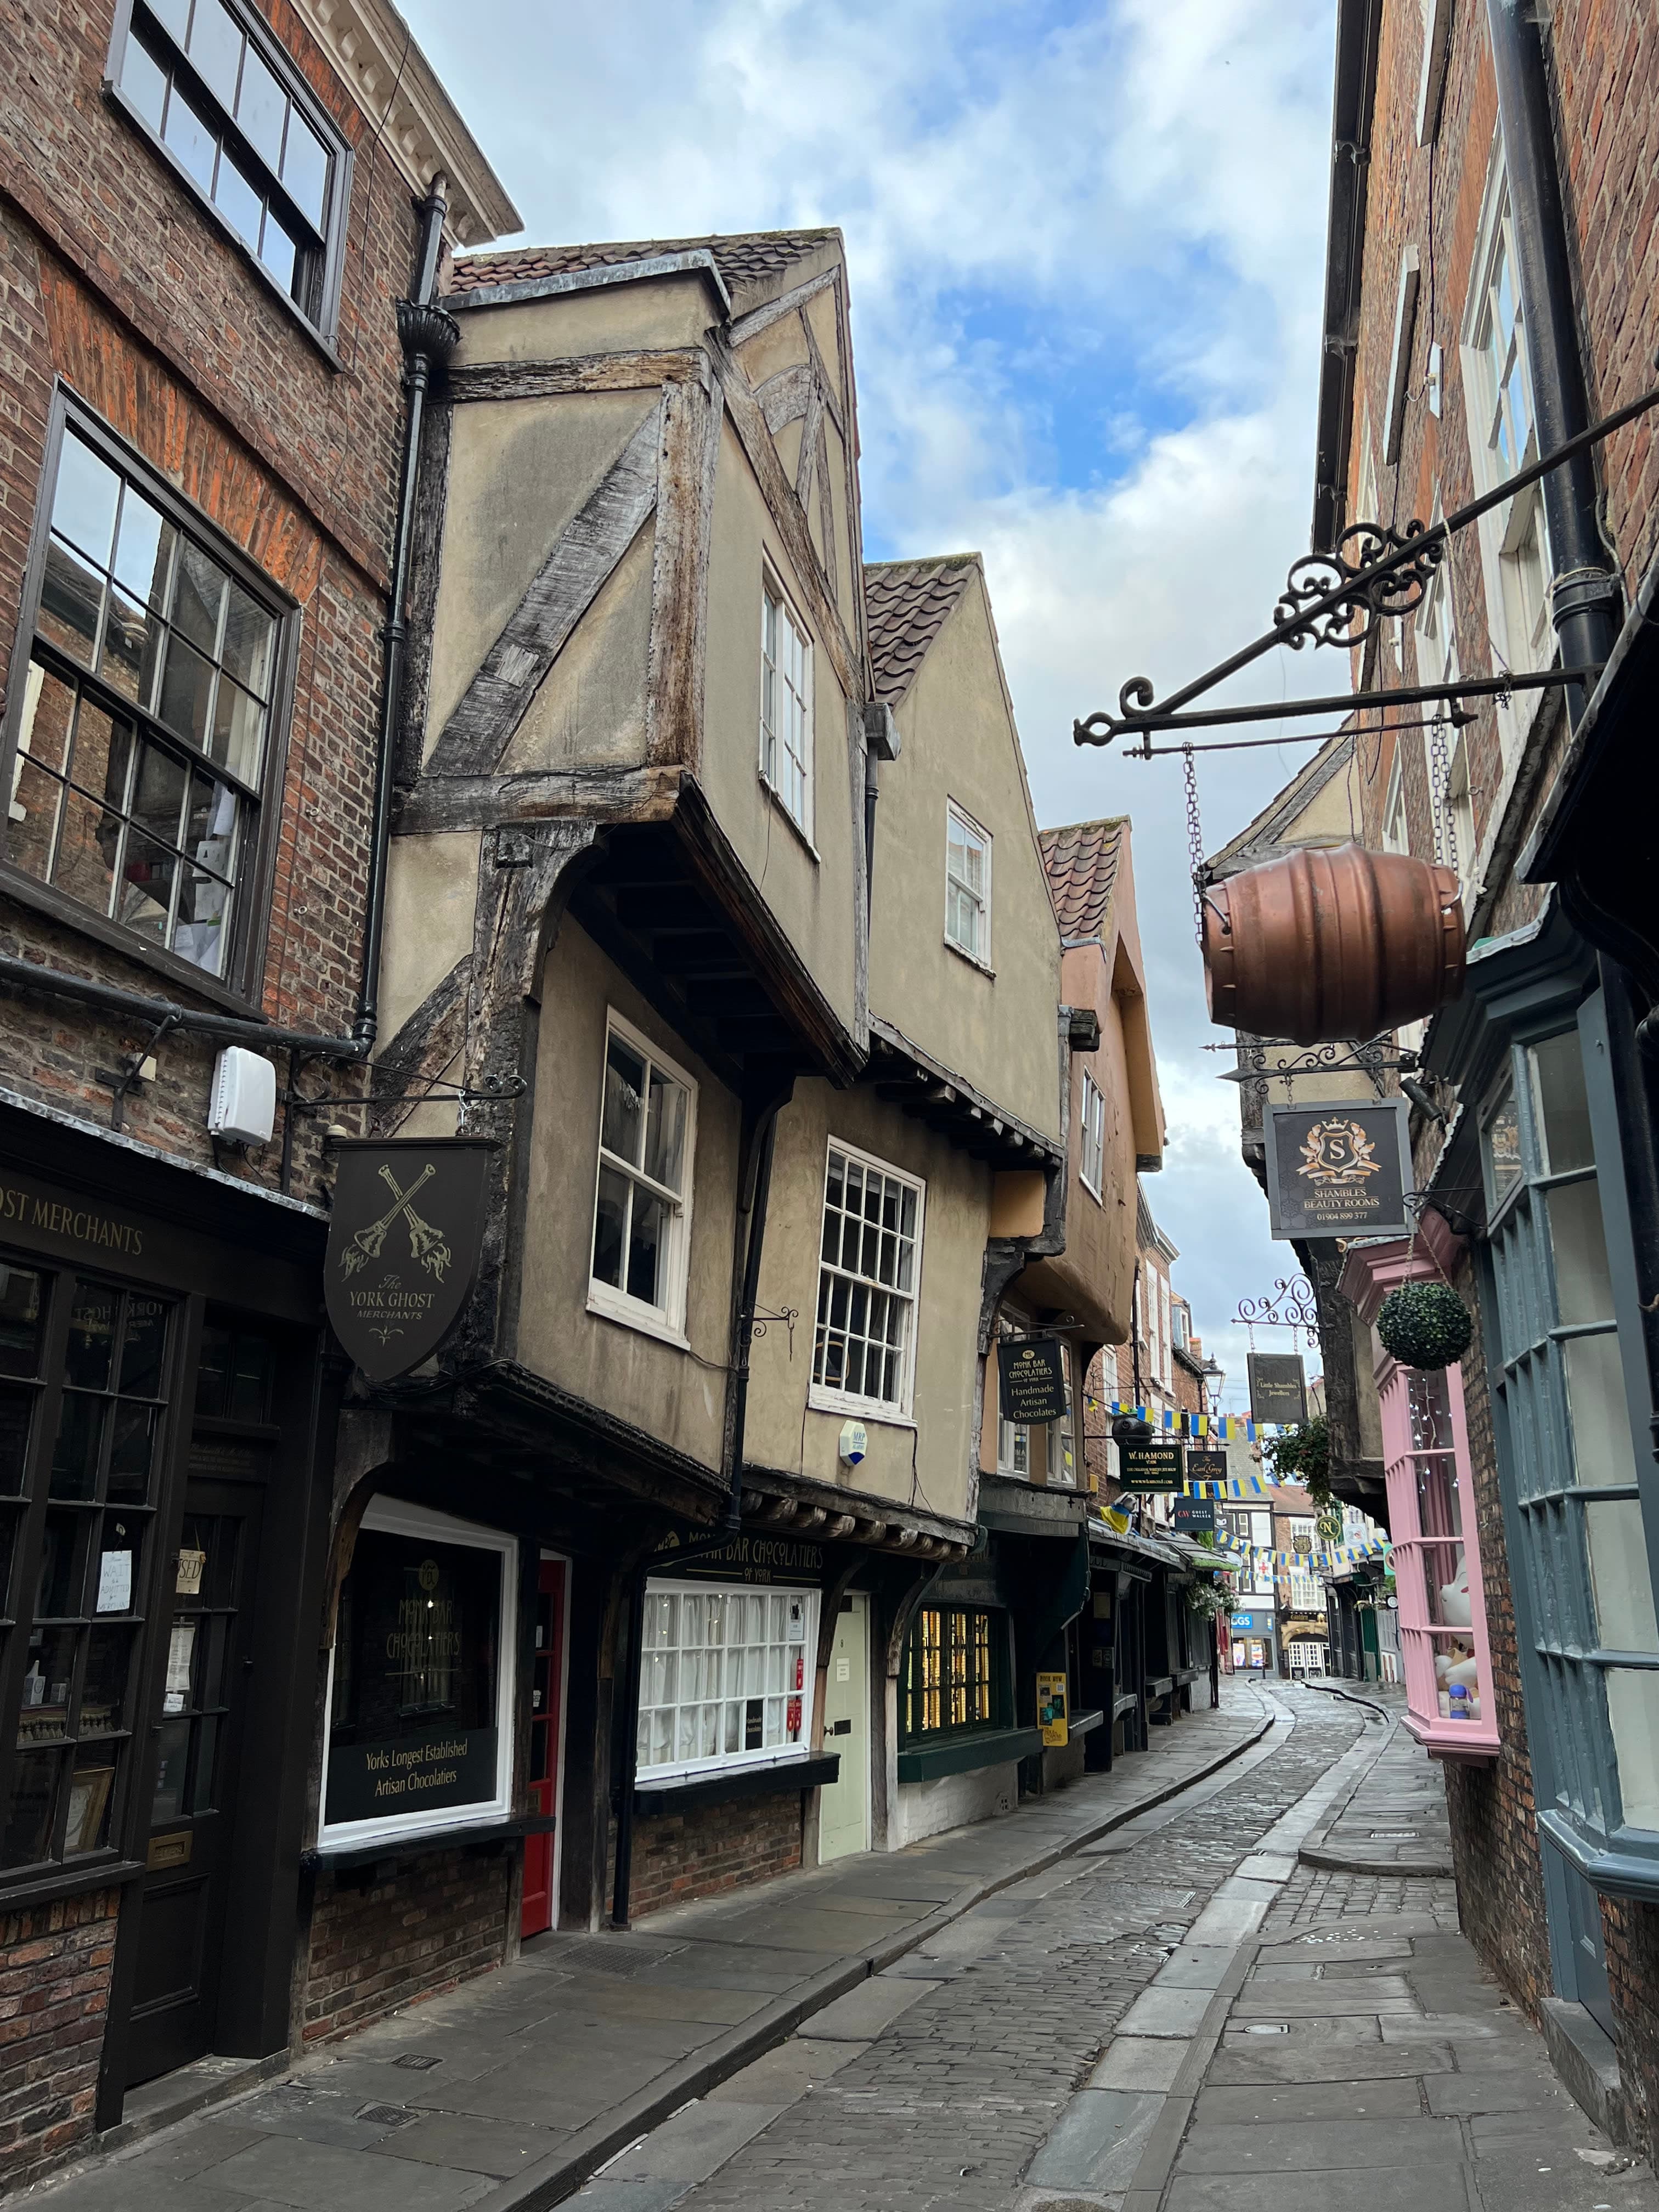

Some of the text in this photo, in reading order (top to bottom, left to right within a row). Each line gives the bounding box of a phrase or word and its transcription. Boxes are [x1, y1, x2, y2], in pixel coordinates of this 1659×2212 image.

[1329, 1139, 1345, 1159] S
[1314, 1188, 1366, 1198] SHAMBLES
[1304, 1198, 1379, 1208] BEAUTY ROOMS
[31, 1198, 142, 1255] MERCHANTS
[379, 1274, 402, 1289] The
[350, 1291, 435, 1308] YORK GHOST
[357, 1310, 422, 1320] MERCHANTS
[1013, 1359, 1046, 1369] MONK BAR
[1009, 1367, 1053, 1378] CHOCOLATIERS
[1011, 1384, 1054, 1396] Handmade
[1020, 1398, 1047, 1406] Artisan
[1013, 1408, 1057, 1419] Chocolates
[753, 1539, 823, 1568] CHOCOLATIERS
[103, 1564, 130, 1577] WAIT
[744, 1567, 771, 1582] OF YORK
[366, 1738, 467, 1770] Yorks Longest Established
[375, 1768, 457, 1797] Artisan Chocolatiers
